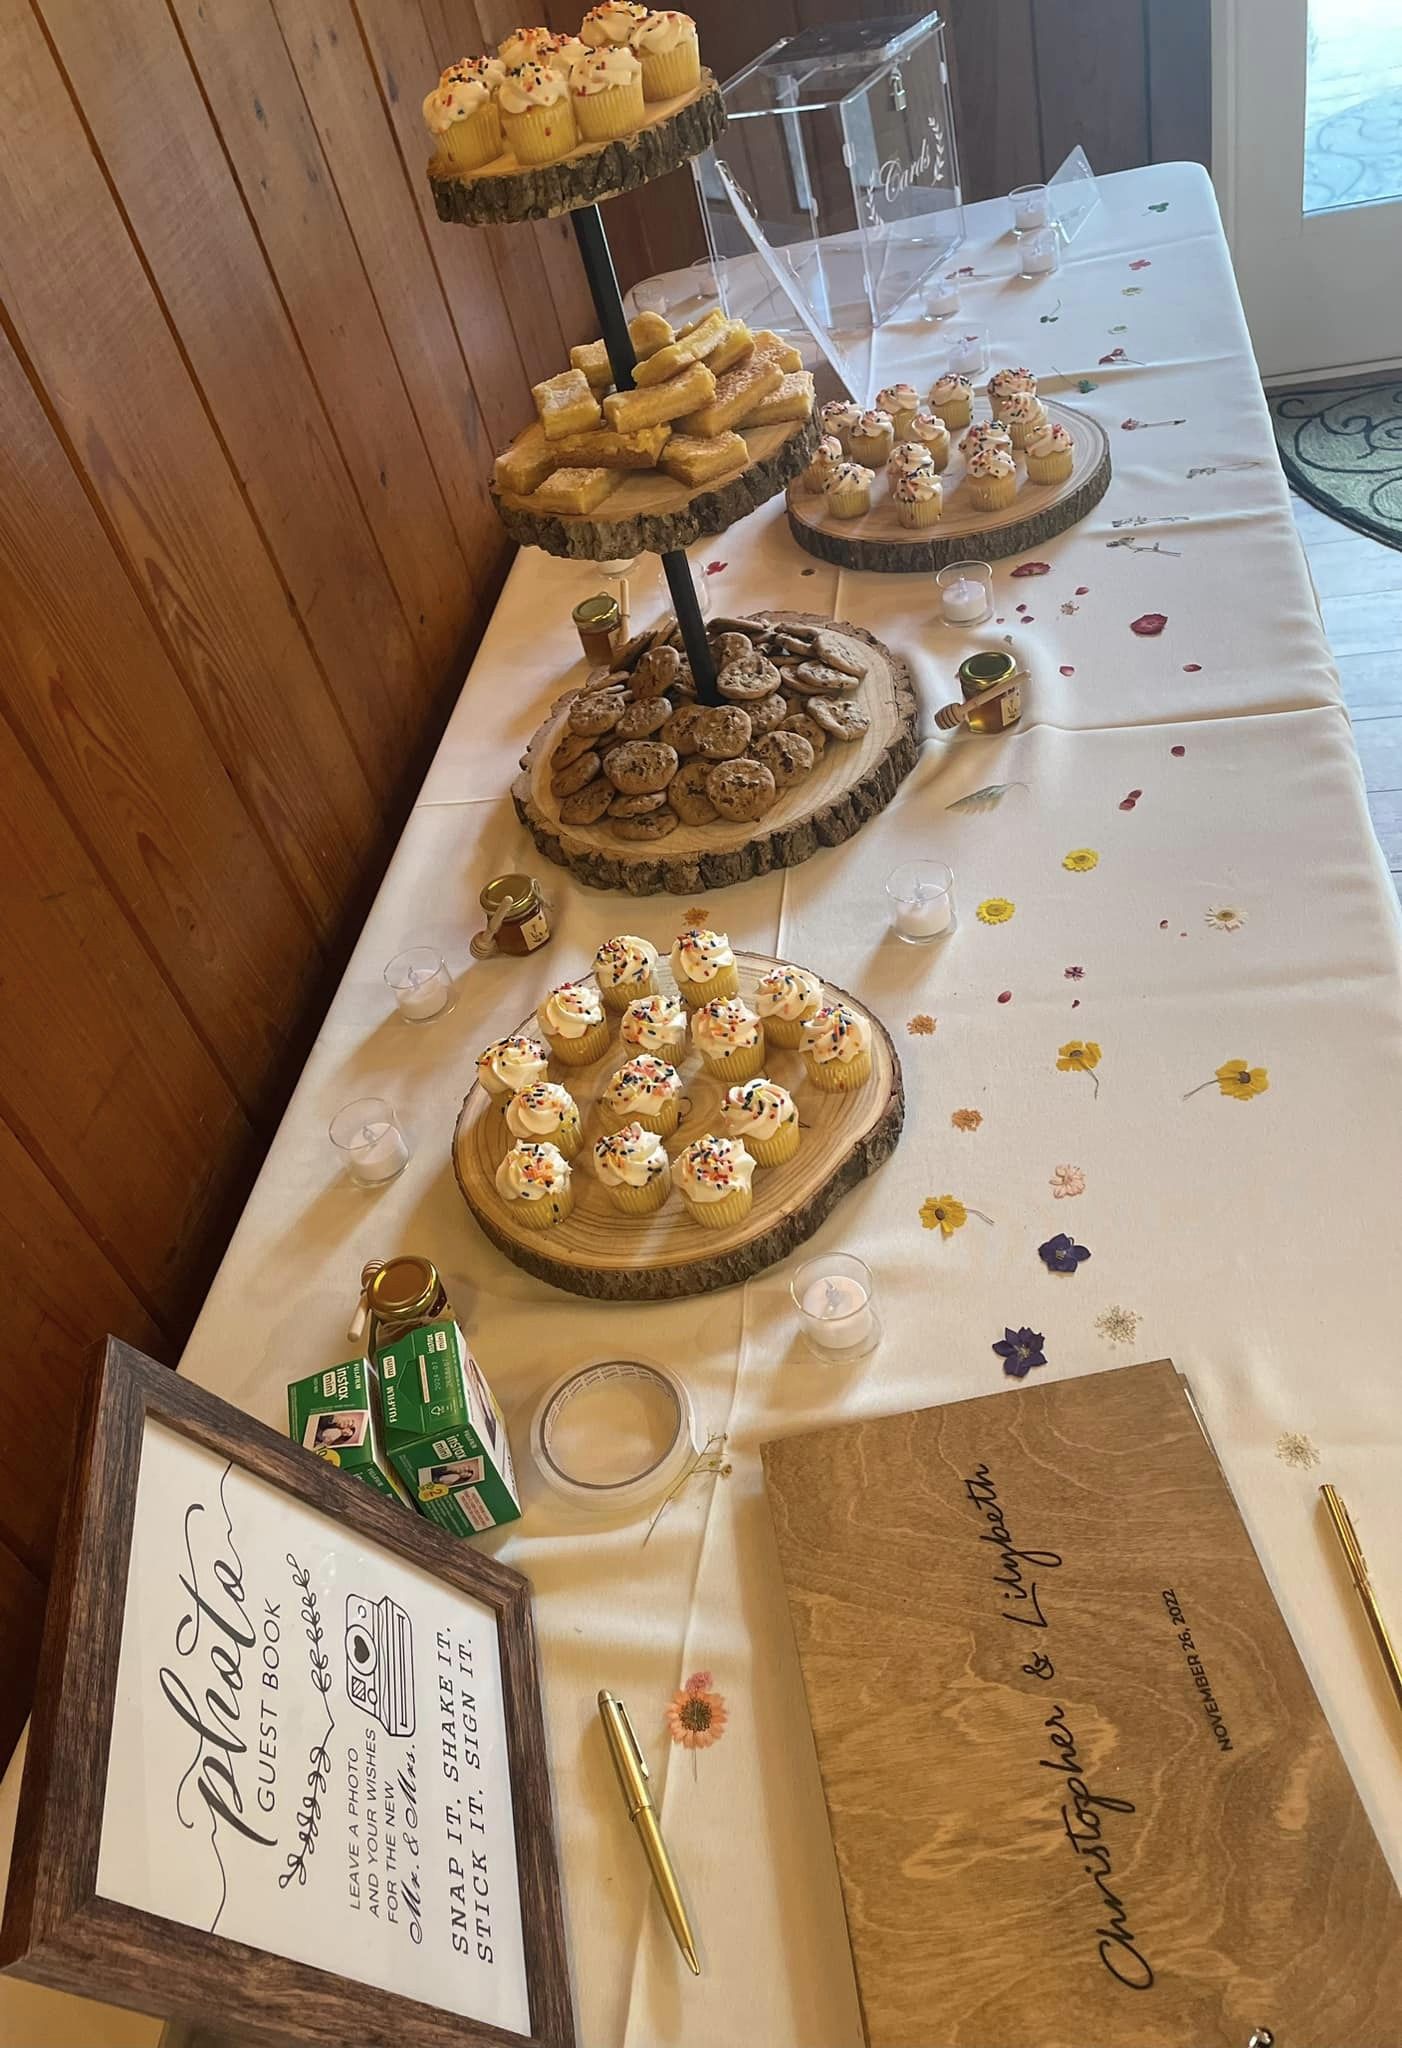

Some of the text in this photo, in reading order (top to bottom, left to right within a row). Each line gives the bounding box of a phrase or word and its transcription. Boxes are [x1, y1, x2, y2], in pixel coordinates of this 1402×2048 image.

[880, 138, 930, 202] Cards
[325, 1373, 335, 1396] mini
[336, 1366, 350, 1401] instax
[386, 1356, 398, 1424] FUJIFILM mini
[427, 1333, 436, 1354] instax
[437, 1332, 446, 1350] mini
[435, 1442, 448, 1458] mini
[446, 1433, 467, 1460] instax
[160, 1503, 278, 1846] photo
[257, 1598, 281, 1813] GUEST BOOK
[965, 1463, 1153, 1990] Christopher & Lilybeth
[1162, 1588, 1234, 1752] NOVEMBER 26, 2022
[347, 1747, 361, 1910] LEAVE A PHOTO
[365, 1728, 380, 1918] AND YOUR WISHES
[384, 1781, 398, 1924] FOR THE NEW
[397, 1744, 423, 1944] Mr. & Mrs.
[437, 1627, 469, 1955] SNAP IT. SHAKE IT.
[458, 1638, 494, 1964] STICK IT. SIGN IT.
